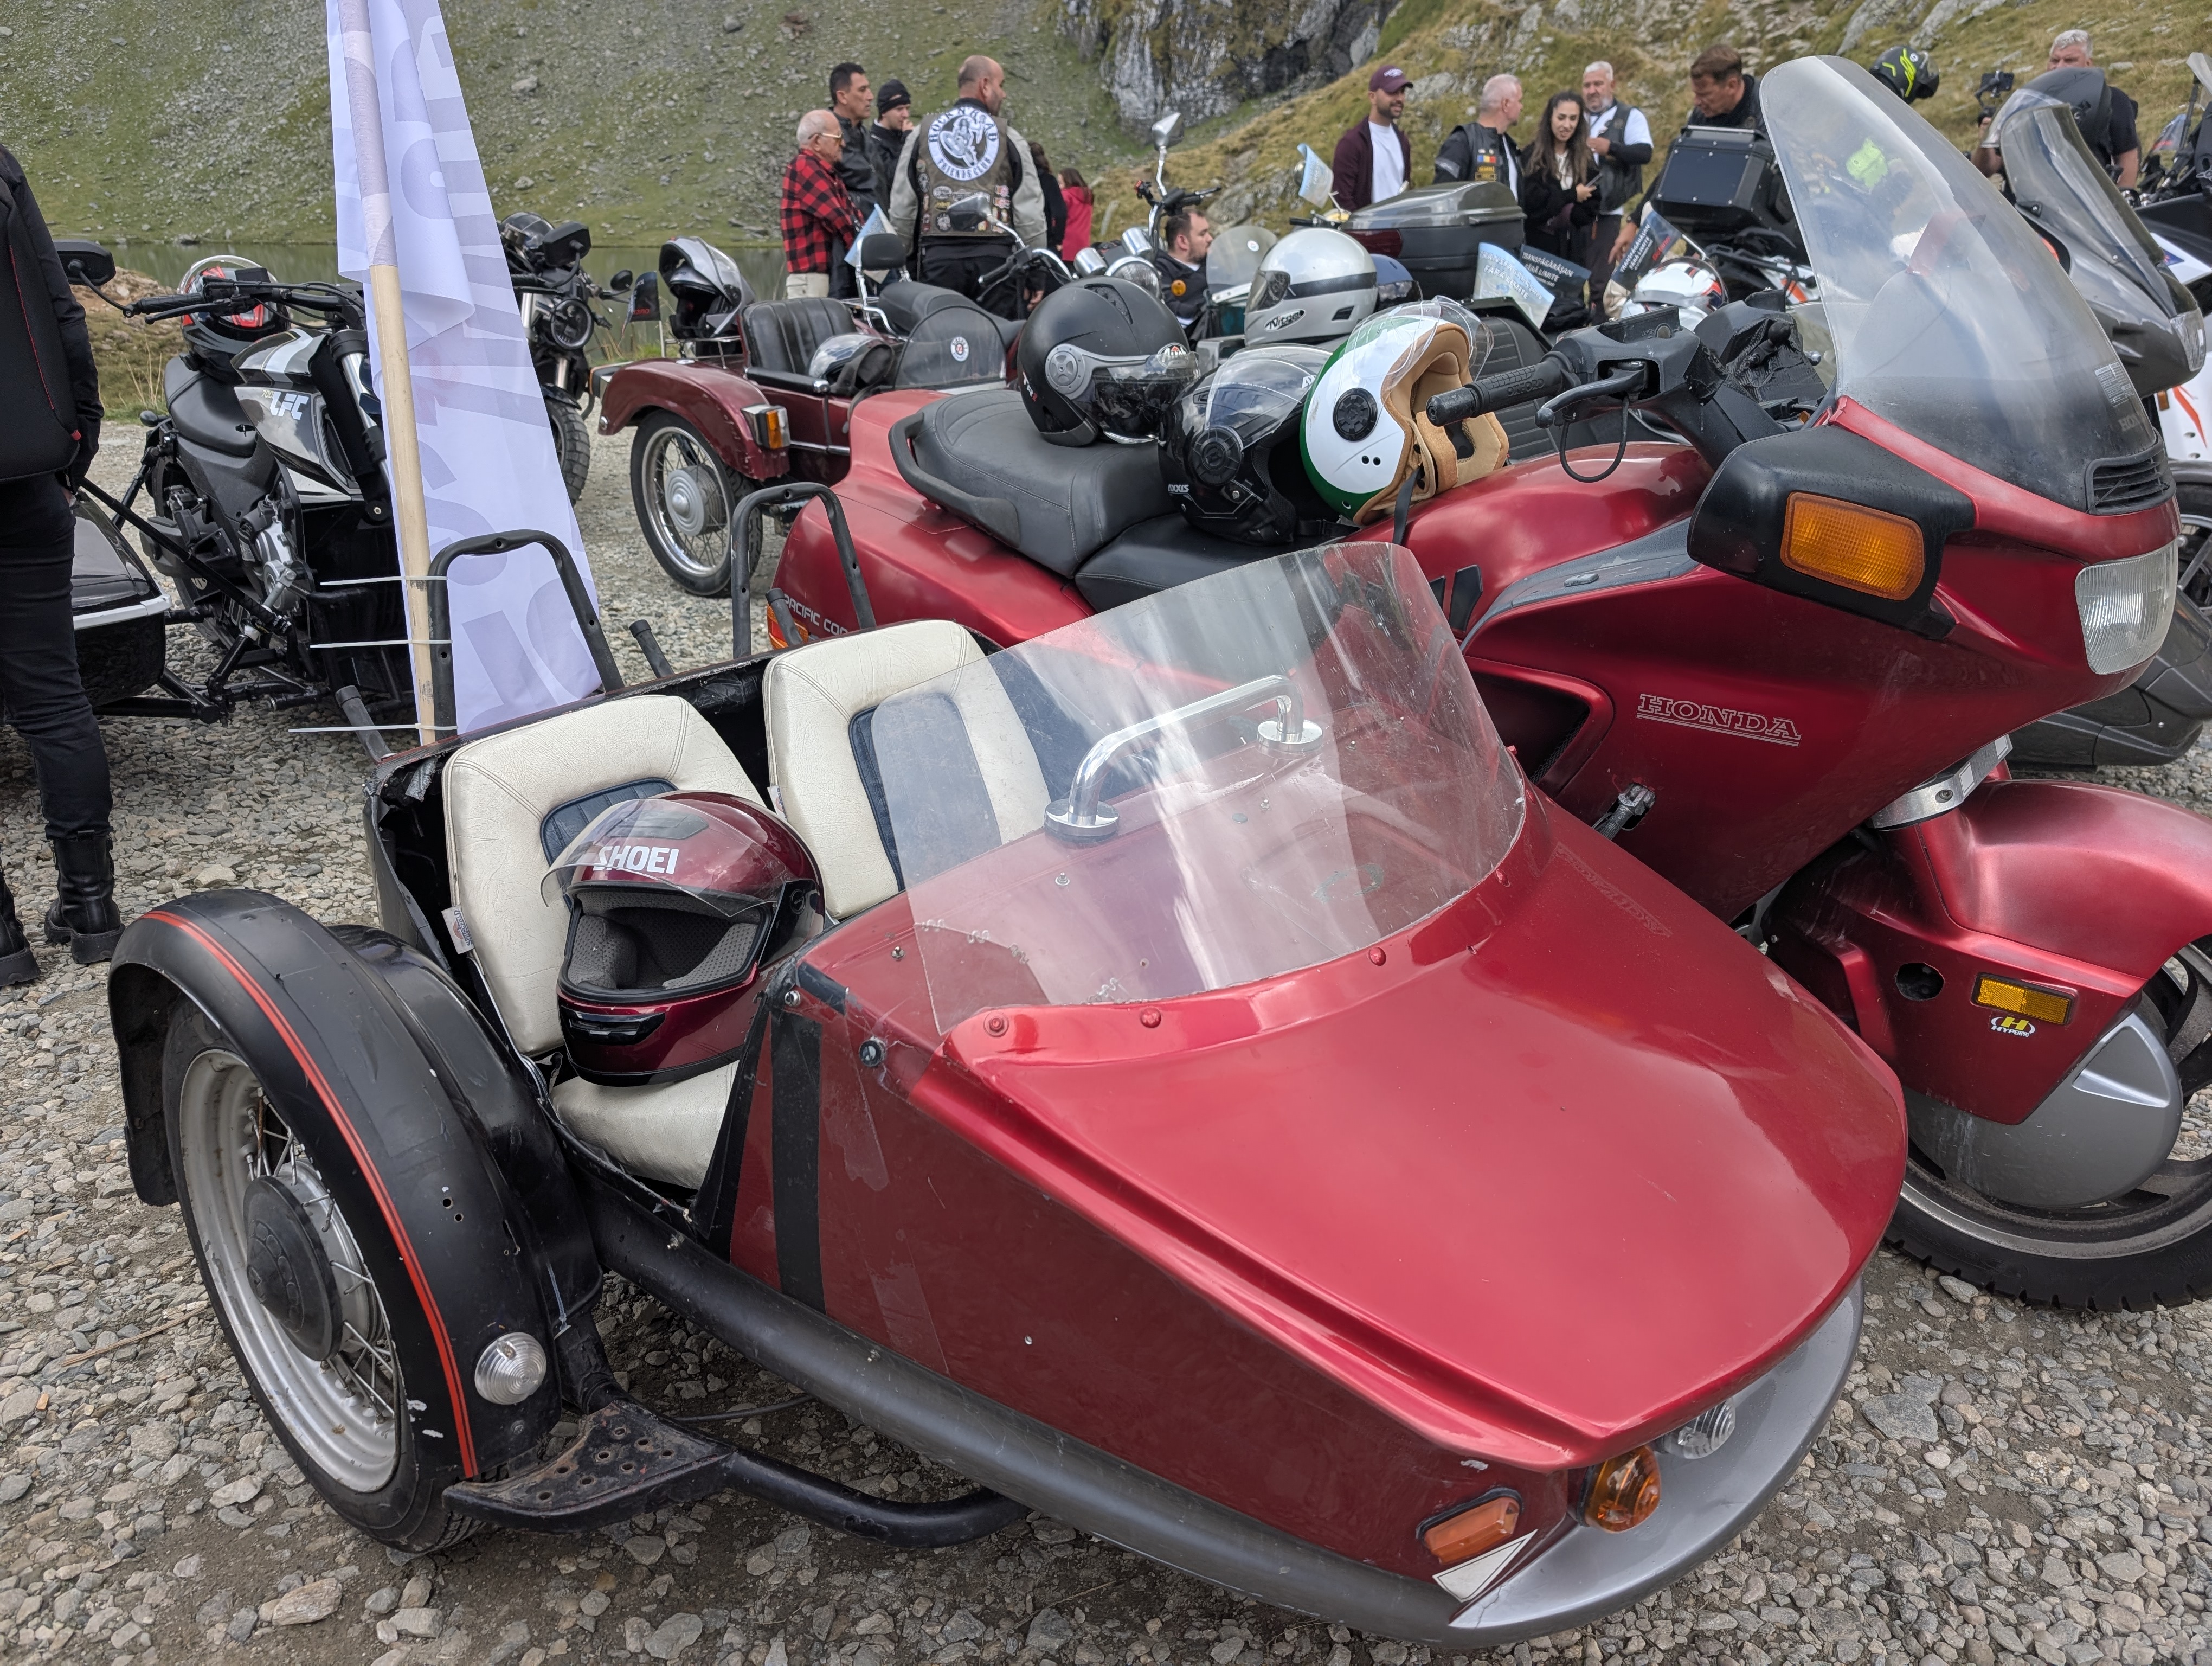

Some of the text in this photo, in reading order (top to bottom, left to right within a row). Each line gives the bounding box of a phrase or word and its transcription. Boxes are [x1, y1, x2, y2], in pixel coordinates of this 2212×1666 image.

[970, 110, 997, 142] RAD
[938, 157, 991, 178] FRIENDS CLUB
[1506, 275, 1529, 299] LIMITE
[261, 390, 274, 398] 700
[1507, 378, 1545, 396] OXFORD
[1167, 484, 1189, 492] AXXIS
[1637, 693, 1802, 741] HONDA
[593, 845, 679, 874] SHOEI
[1991, 1025, 2030, 1037] HYPERPRO
